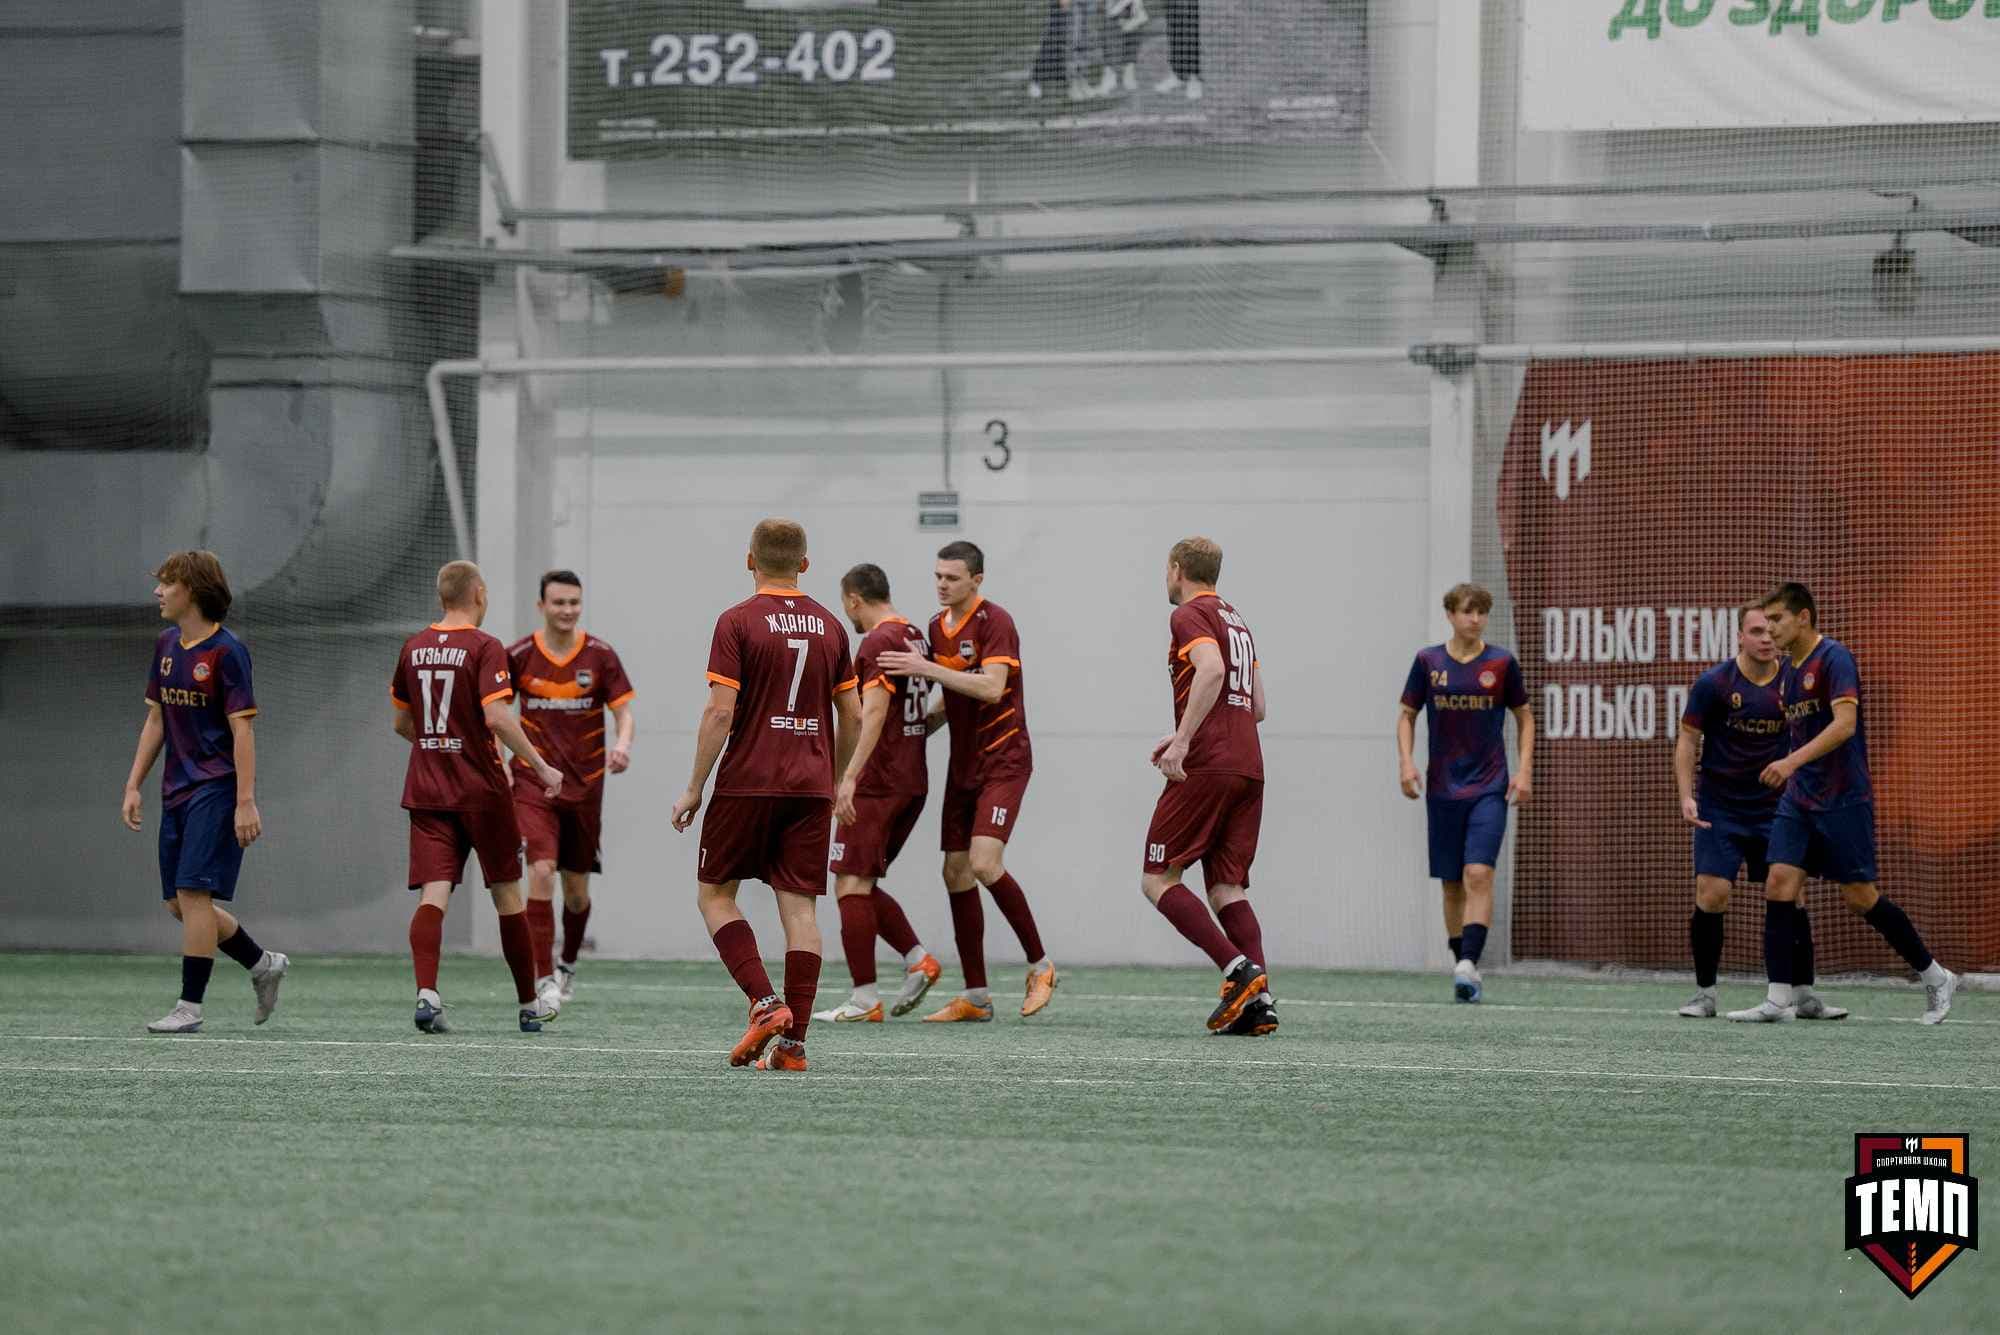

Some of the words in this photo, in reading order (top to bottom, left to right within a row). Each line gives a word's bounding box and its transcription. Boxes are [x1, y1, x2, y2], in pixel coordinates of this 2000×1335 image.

[1728, 0, 2000, 36] ЗДОРО
[984, 419, 1010, 471] 3
[765, 613, 825, 635] ЖДАНОВ
[1543, 607, 1656, 663] ОЛЬКО
[411, 647, 468, 667] КУЗЬКИН
[1228, 627, 1253, 697] 90
[787, 638, 809, 712] 7
[1430, 670, 1448, 687] 24
[160, 687, 208, 706] АССВЕТ
[418, 670, 456, 734] 17
[1731, 692, 1742, 709] 9
[1544, 683, 1656, 740] ОЛЬКО
[770, 716, 819, 730] SEUS
[991, 806, 1007, 826] 15
[701, 847, 707, 868] 7
[1149, 843, 1165, 862] 90
